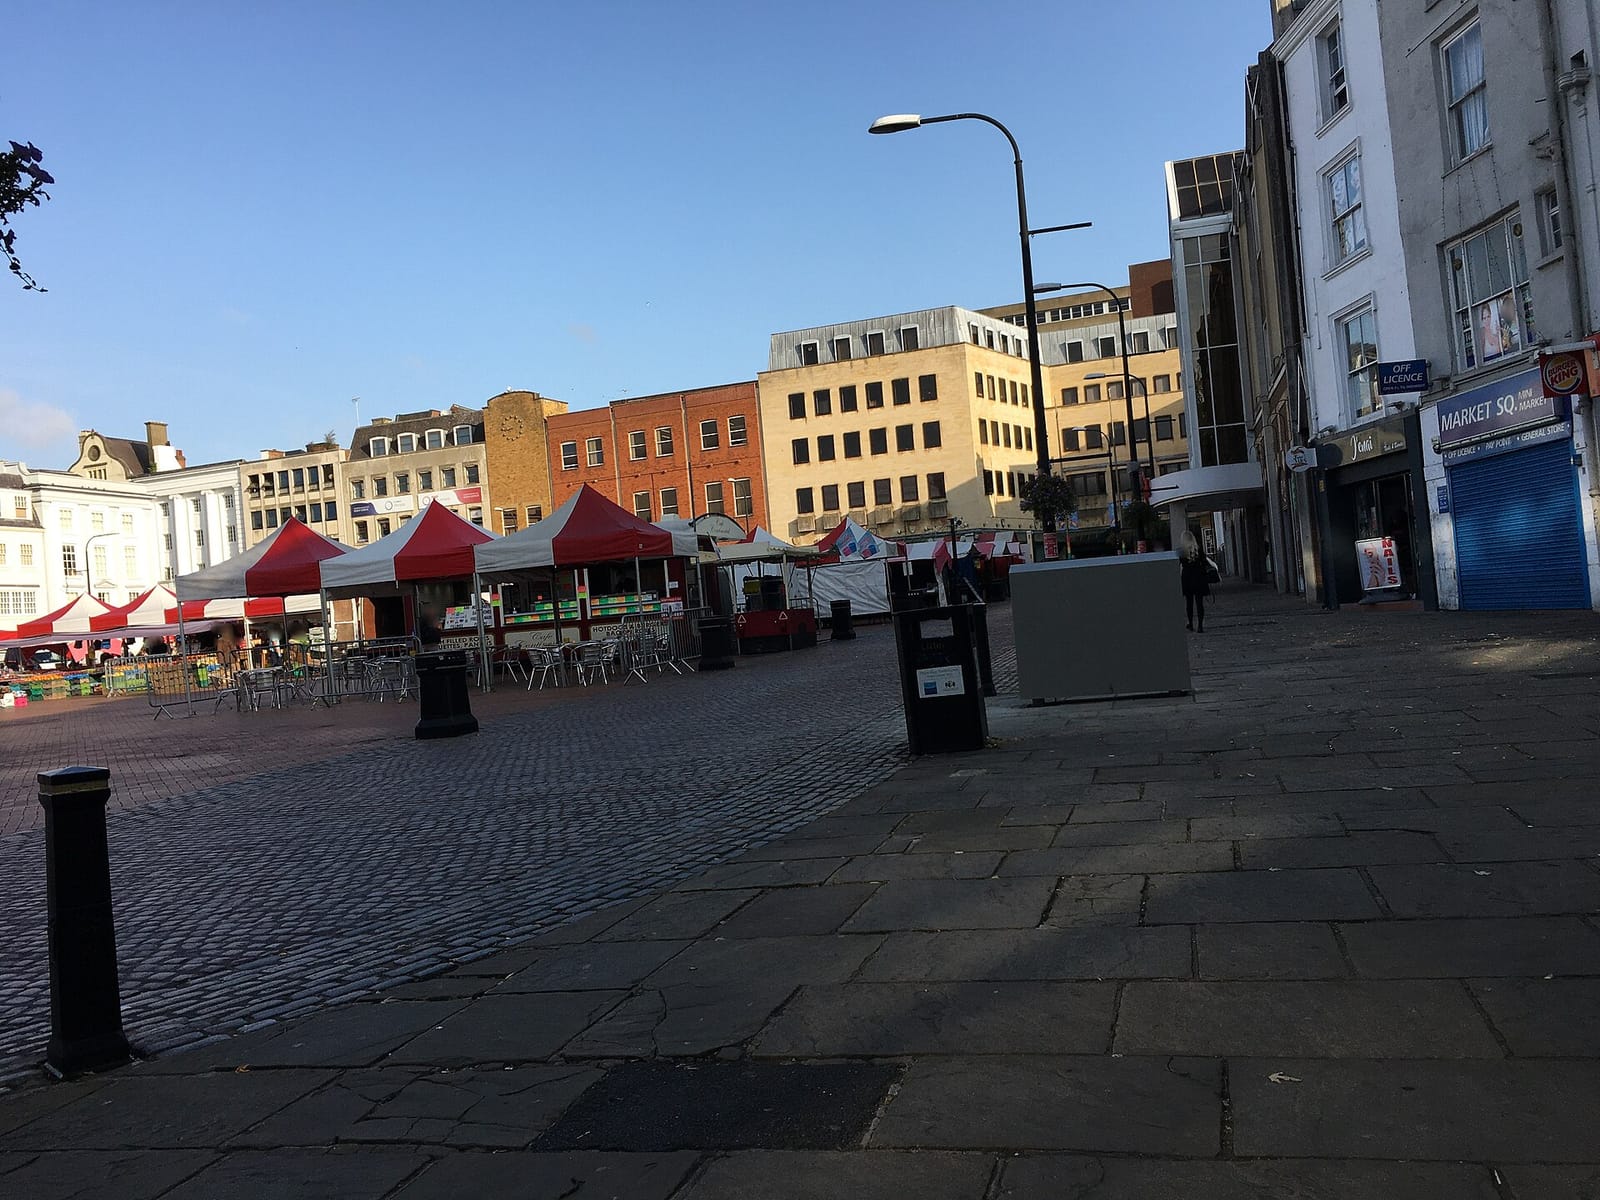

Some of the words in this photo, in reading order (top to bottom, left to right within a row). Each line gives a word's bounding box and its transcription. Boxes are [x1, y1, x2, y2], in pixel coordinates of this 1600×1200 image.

[1392, 363, 1412, 373] OFF
[1548, 360, 1577, 377] BURGER
[1551, 366, 1578, 386] KING
[1383, 372, 1424, 384] LICENCE
[1518, 388, 1533, 400] MINI
[1519, 397, 1547, 411] MARKET
[1441, 400, 1493, 432] MARKET
[1496, 394, 1518, 416] SQ.
[1521, 429, 1546, 441] GENERAL
[1546, 424, 1566, 436] STORE
[1382, 538, 1398, 584] NAILS
